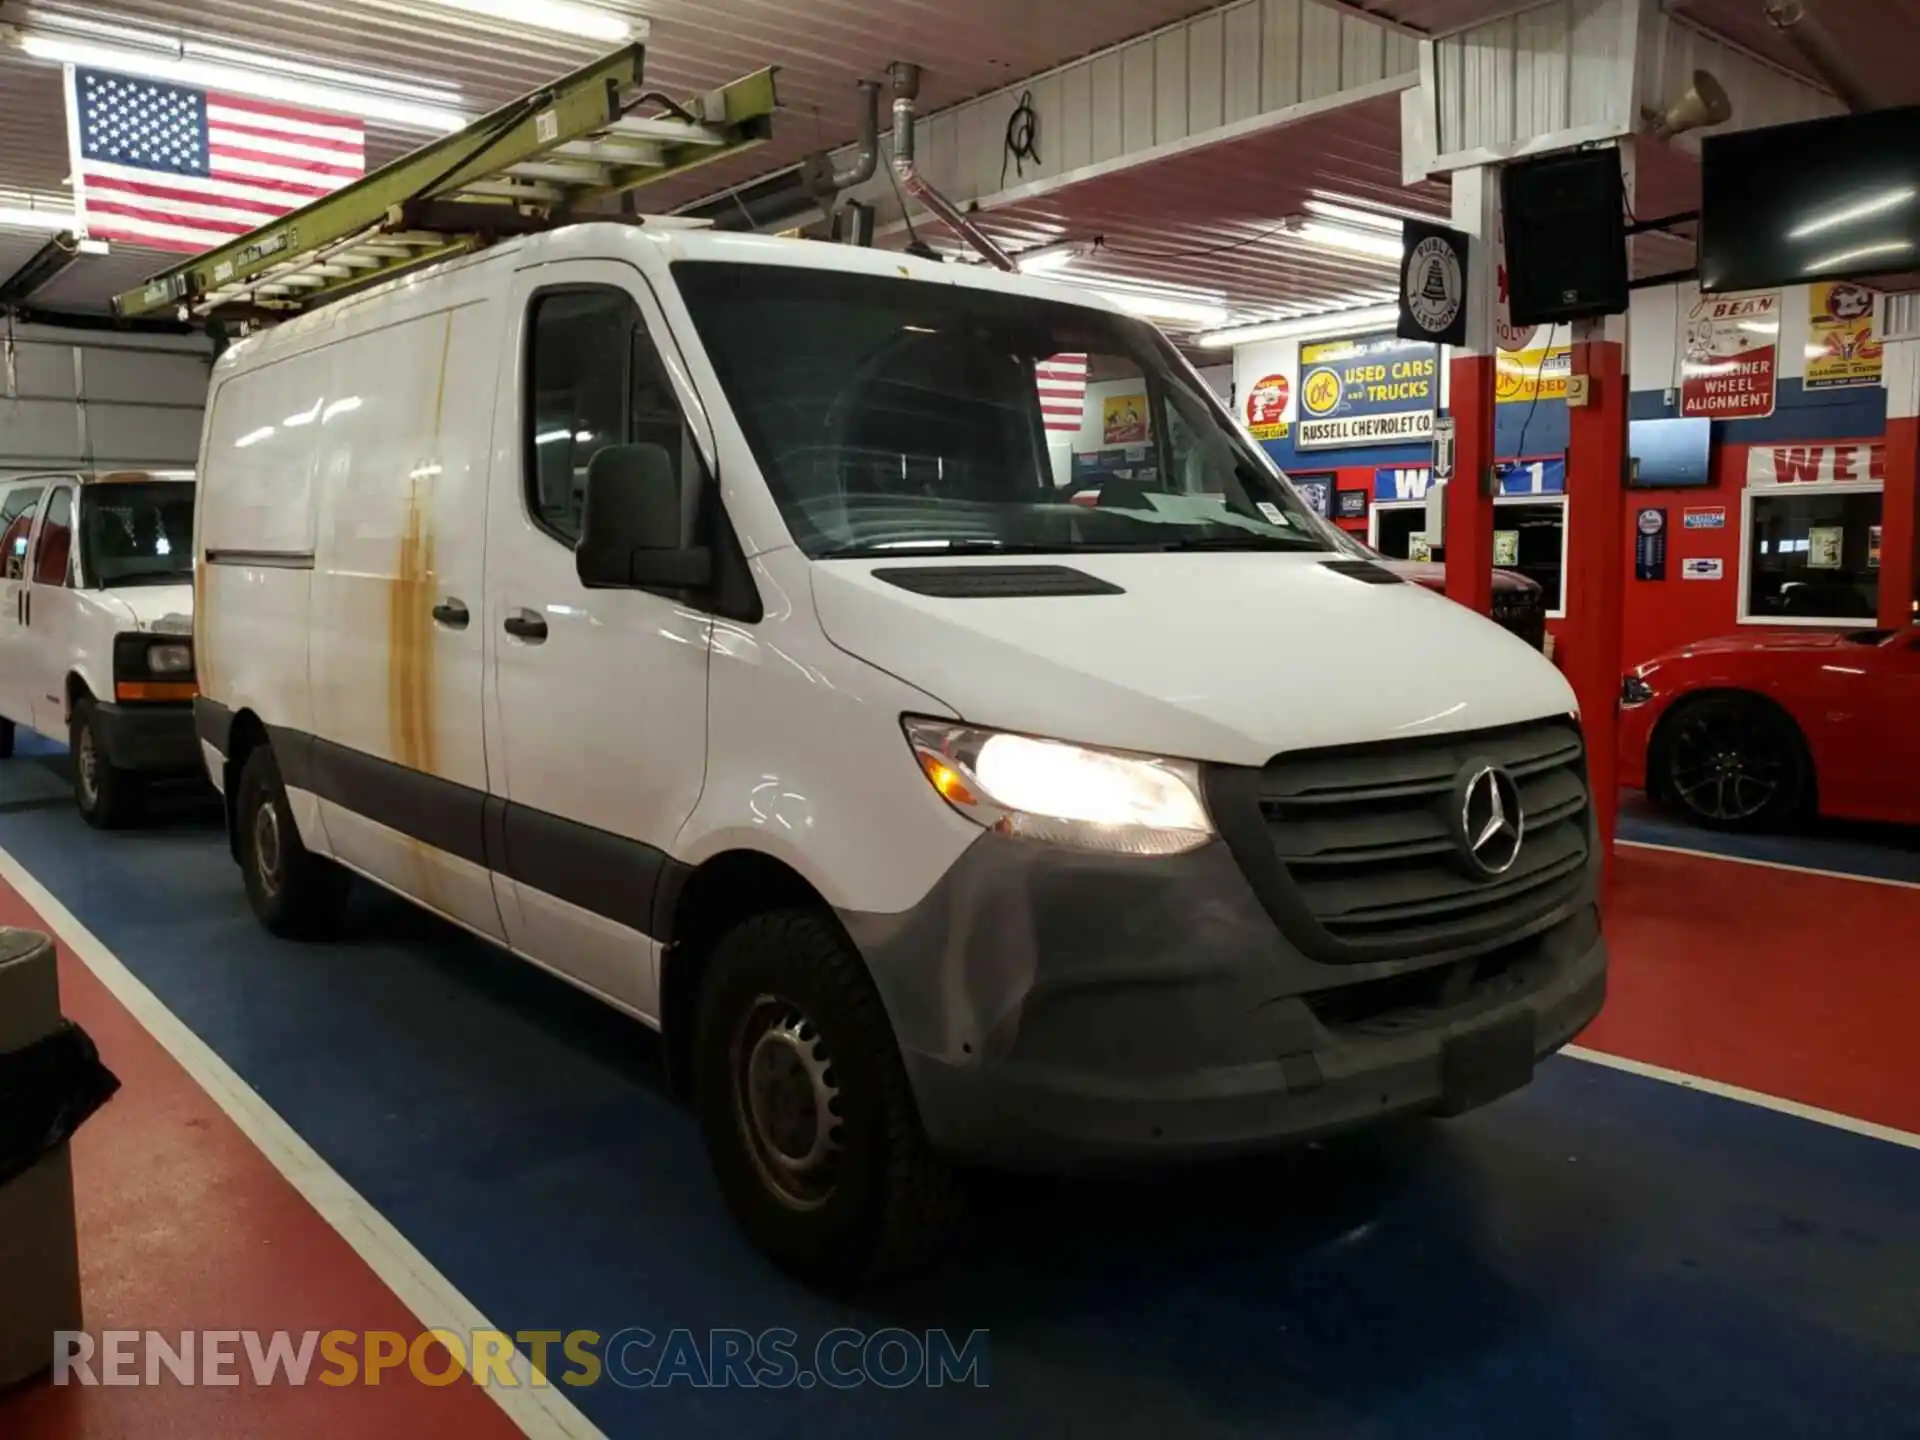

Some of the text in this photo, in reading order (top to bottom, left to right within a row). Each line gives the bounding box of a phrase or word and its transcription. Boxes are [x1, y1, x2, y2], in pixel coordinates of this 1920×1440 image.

[1417, 237, 1457, 264] PUBLIC
[1409, 290, 1458, 329] TELEPHONE
[1713, 298, 1773, 318] BEAN
[1345, 359, 1434, 384] USED CARS
[1311, 377, 1332, 405] OK
[1367, 381, 1429, 402] TRUCKS
[1524, 379, 1567, 393] USED
[1704, 378, 1756, 394] WHEEL
[1686, 393, 1770, 411] ALIGNMENT
[1302, 422, 1348, 441] RUSSELL
[1351, 416, 1414, 436] CHEVROLET
